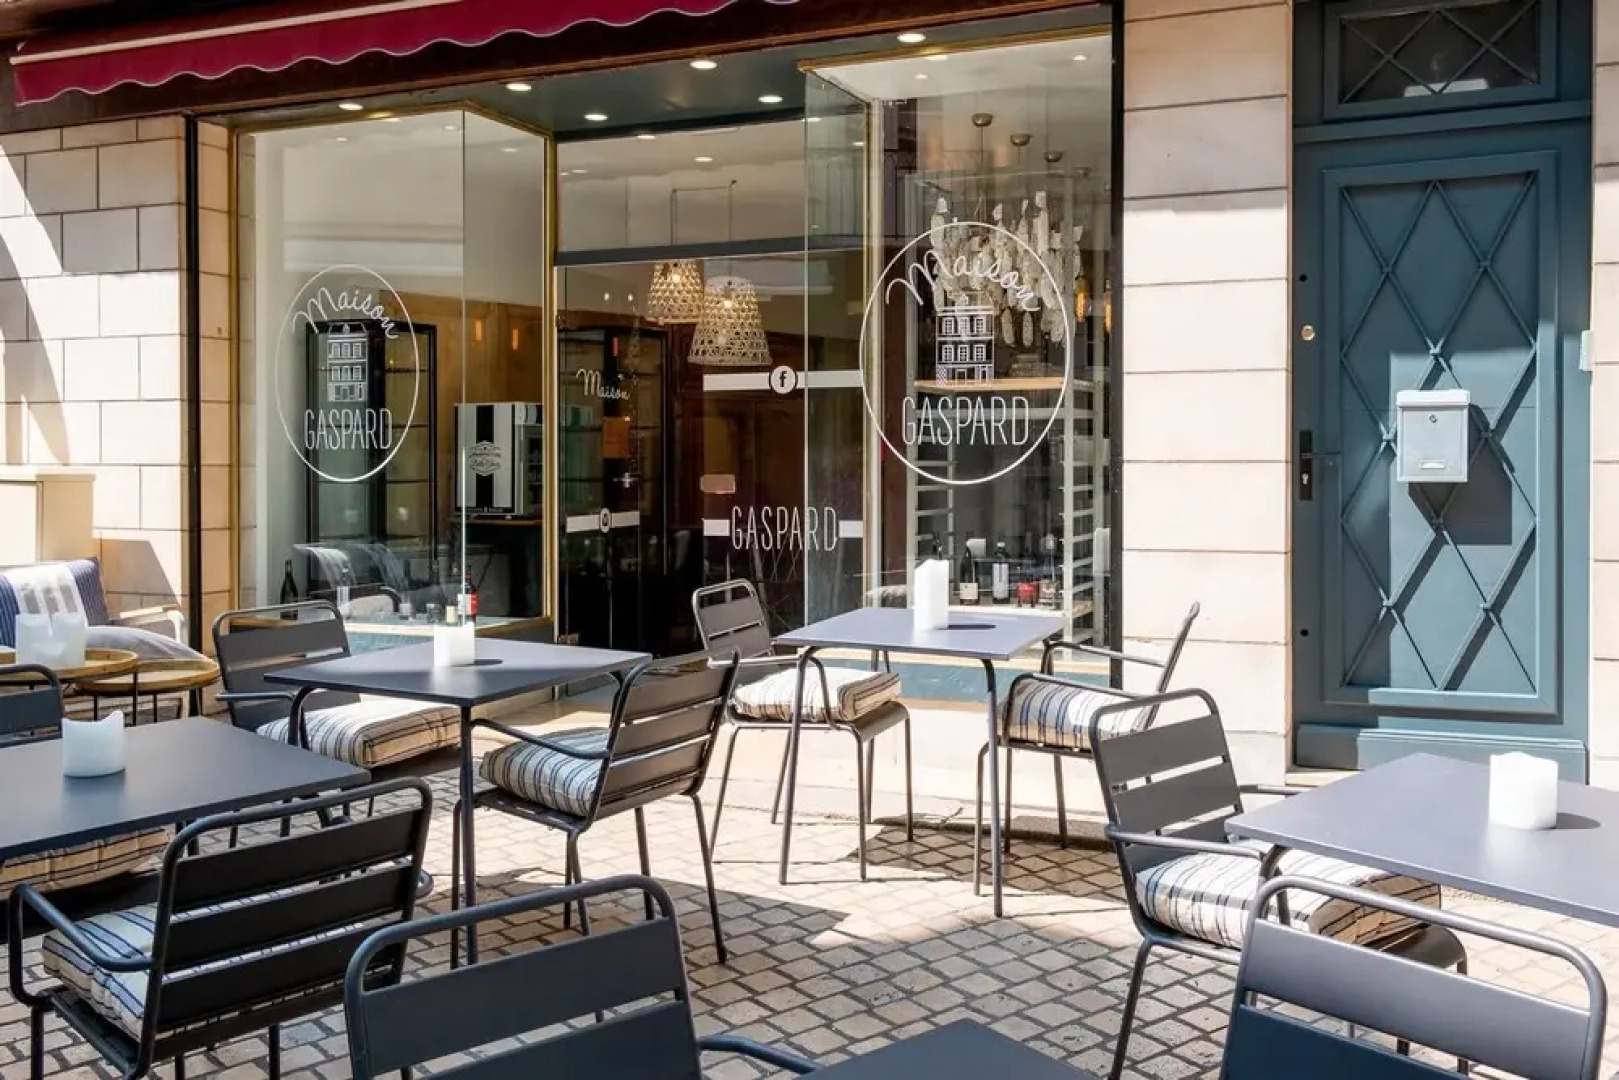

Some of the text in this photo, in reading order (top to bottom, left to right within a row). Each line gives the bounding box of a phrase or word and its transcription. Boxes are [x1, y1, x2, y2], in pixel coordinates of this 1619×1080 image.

[885, 249, 1040, 312] Maison
[292, 287, 399, 340] Maison
[304, 408, 393, 451] GASPARD
[901, 396, 1029, 446] GASPARD
[731, 506, 838, 552] GASPARD
